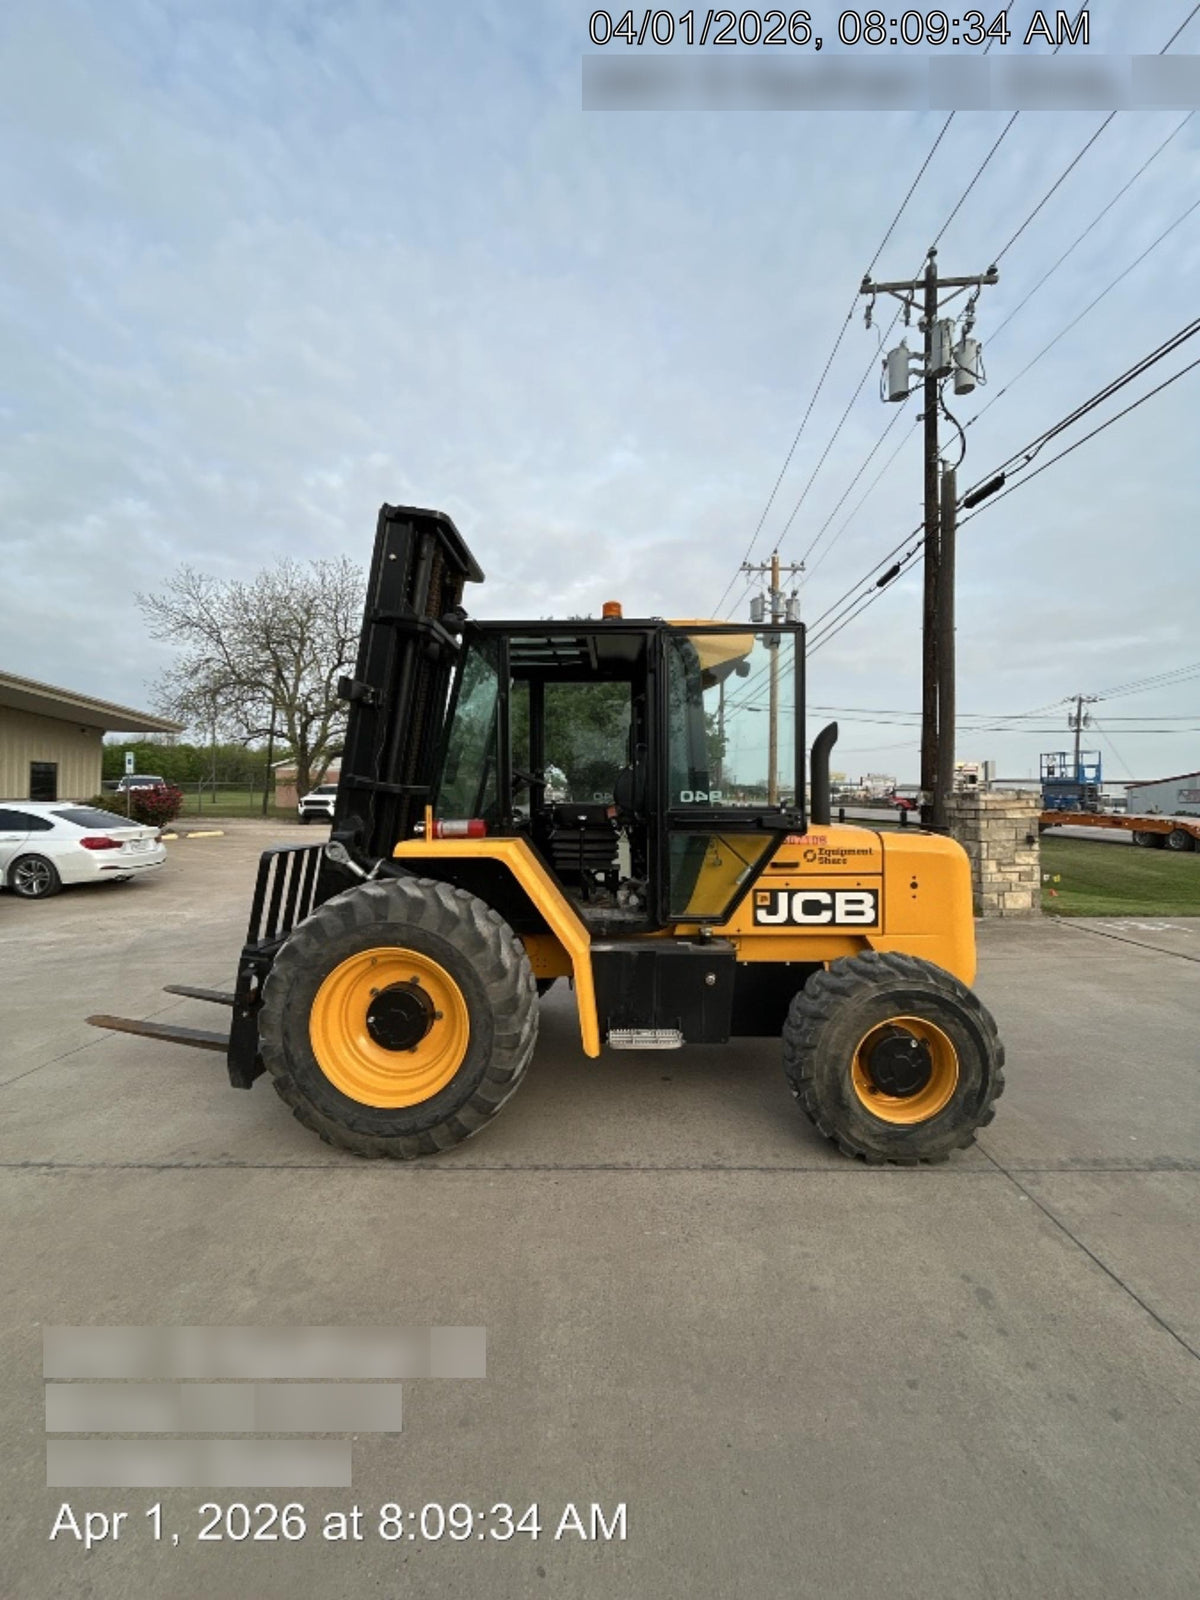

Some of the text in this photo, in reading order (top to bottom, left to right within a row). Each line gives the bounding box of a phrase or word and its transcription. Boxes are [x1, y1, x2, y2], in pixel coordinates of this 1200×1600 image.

[817, 847, 874, 856] Equipment
[817, 857, 848, 865] Share
[756, 891, 876, 924] JCB
